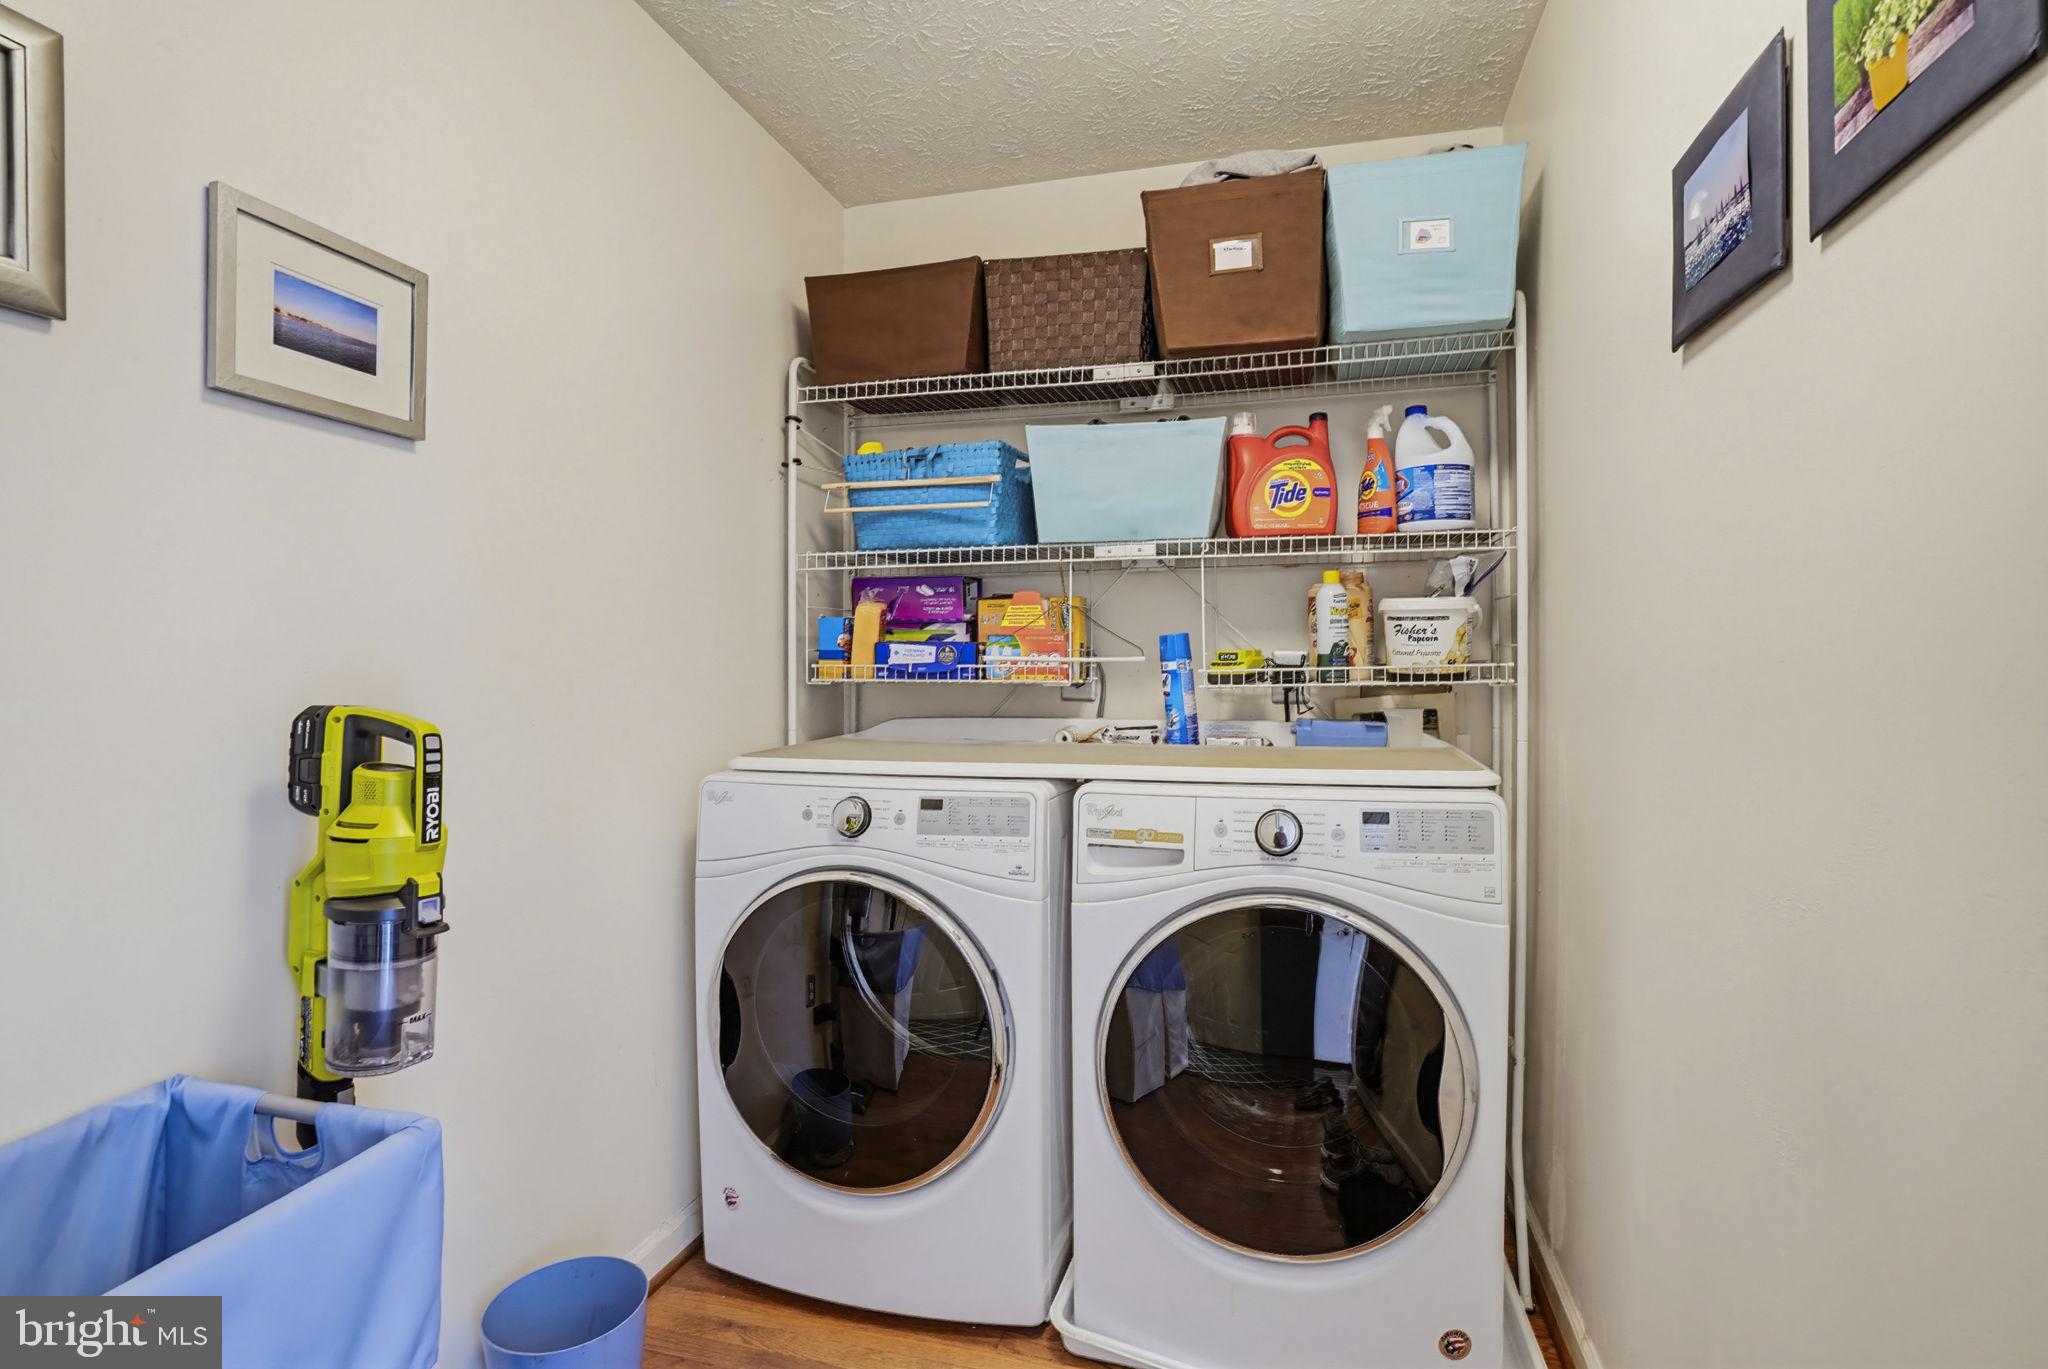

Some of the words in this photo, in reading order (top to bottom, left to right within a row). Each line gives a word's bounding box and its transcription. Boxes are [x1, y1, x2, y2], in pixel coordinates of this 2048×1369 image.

[1269, 481, 1307, 510] Tide
[1393, 623, 1437, 637] Fisher's
[426, 787, 440, 842] RYOBI
[409, 1012, 426, 1024] MAX
